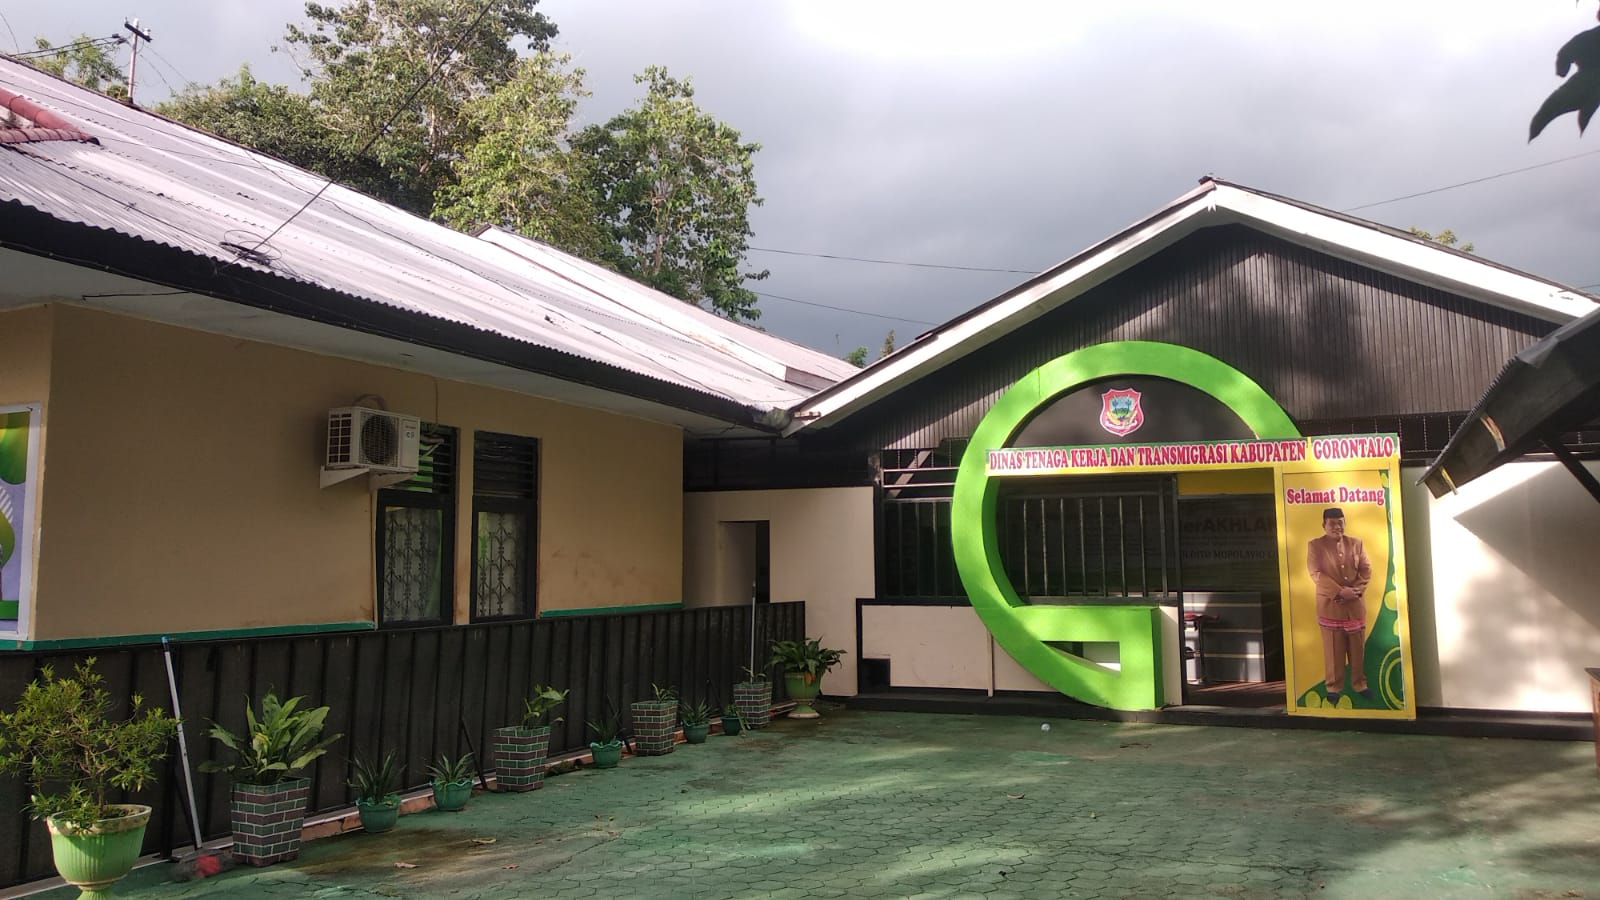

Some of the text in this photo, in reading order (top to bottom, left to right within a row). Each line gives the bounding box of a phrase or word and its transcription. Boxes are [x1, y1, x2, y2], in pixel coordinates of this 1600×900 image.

[989, 437, 1394, 470] DINAS TENAGA KERJA DAN TRANSMIGRASI KABUPATEN GORONTALO
[1287, 486, 1385, 506] Selamat Datang
